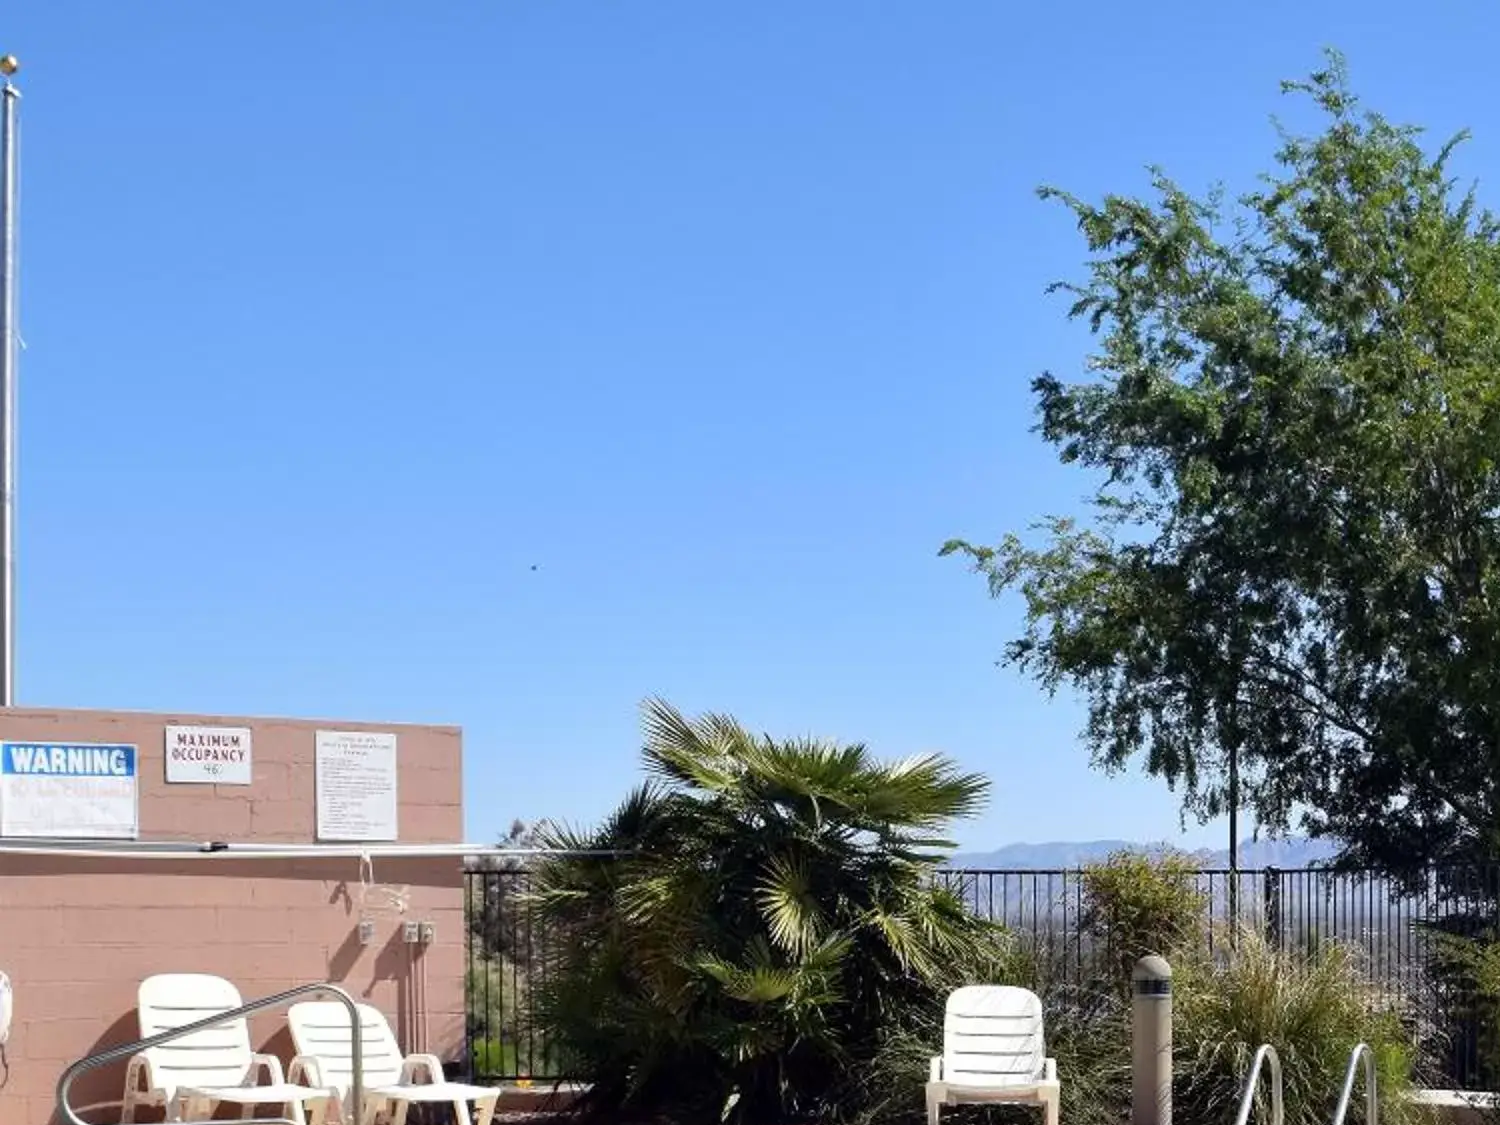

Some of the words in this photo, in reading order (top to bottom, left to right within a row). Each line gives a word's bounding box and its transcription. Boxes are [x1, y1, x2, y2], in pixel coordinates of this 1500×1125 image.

[177, 733, 241, 747] MAXIMUM
[10, 746, 127, 775] WARNING
[171, 747, 246, 762] OCCUPANCY
